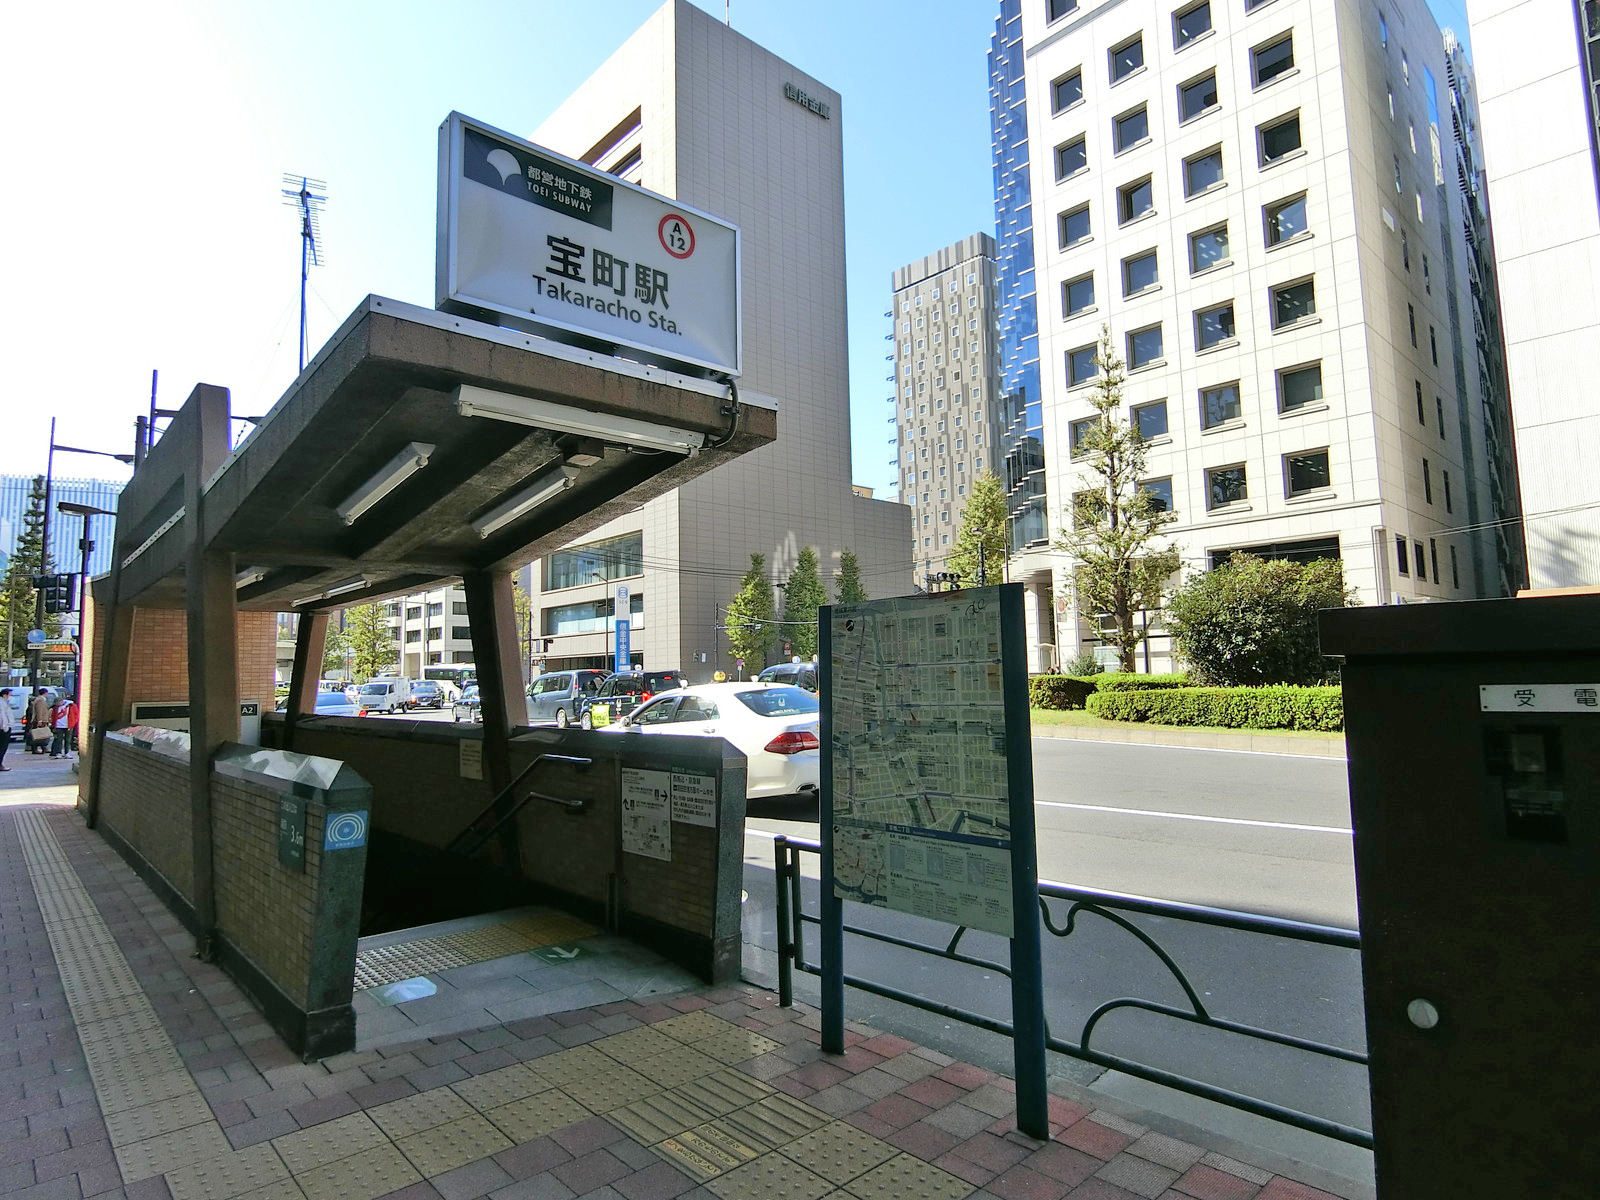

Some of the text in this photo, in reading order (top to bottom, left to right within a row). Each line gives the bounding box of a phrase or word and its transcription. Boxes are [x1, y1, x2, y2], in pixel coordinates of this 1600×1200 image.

[784, 81, 830, 120] 信用金庫
[527, 165, 593, 201] 都営地下鉄
[527, 181, 593, 213] TOEI SUBWAY
[669, 234, 686, 251] 12
[672, 222, 682, 235] A
[545, 233, 670, 310] 宝町駅
[532, 274, 683, 336] Takaracho Sta.
[619, 622, 627, 665] 信金中央金庫
[241, 706, 253, 714] A2
